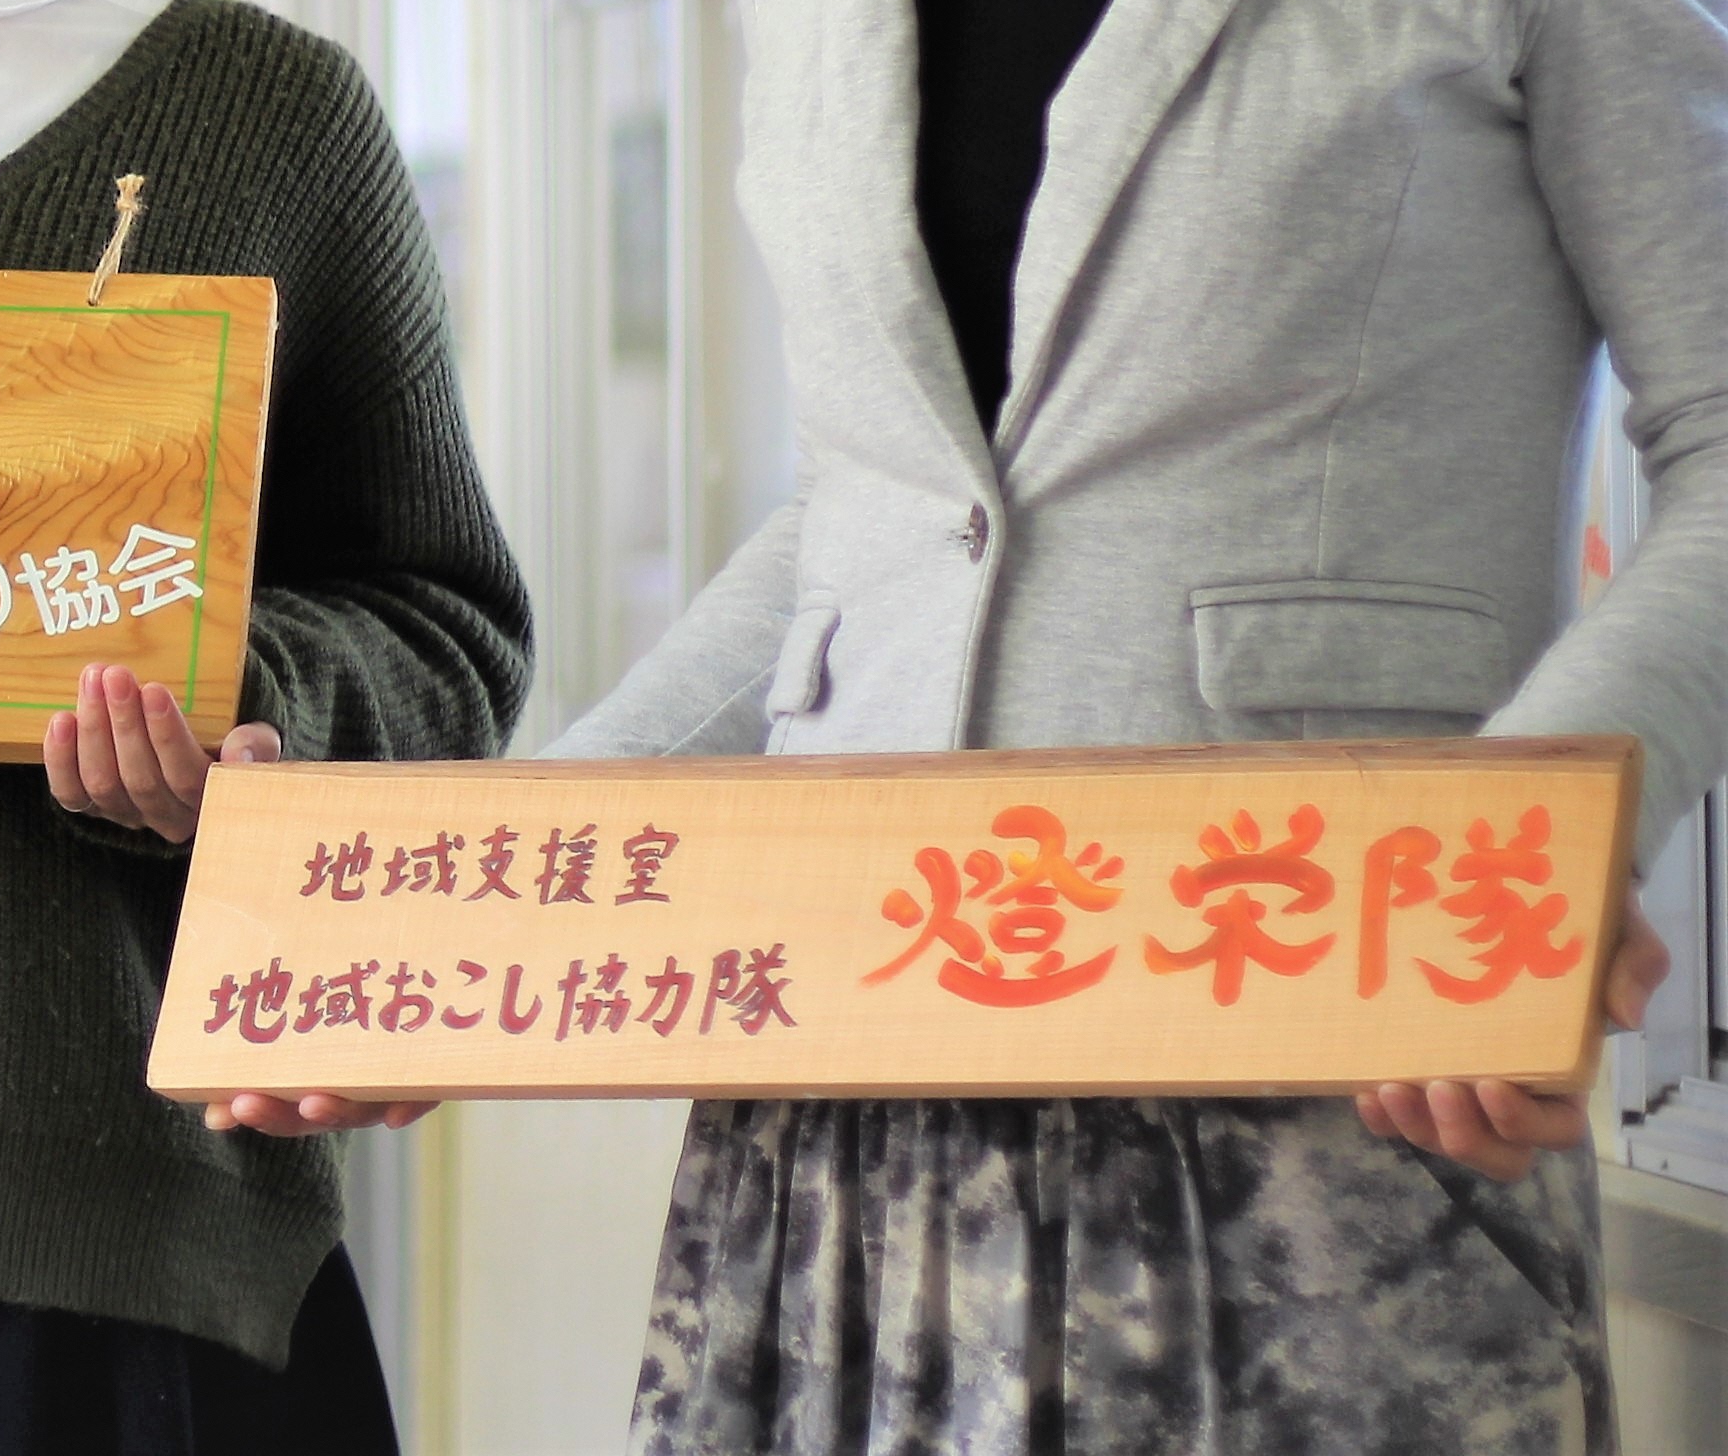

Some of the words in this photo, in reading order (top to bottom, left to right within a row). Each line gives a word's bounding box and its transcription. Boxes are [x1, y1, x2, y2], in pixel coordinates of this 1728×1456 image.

[299, 823, 680, 905] 地域支援室
[857, 803, 1586, 1008] 燈栄隊
[204, 943, 799, 1043] 地域おこし協力隊
